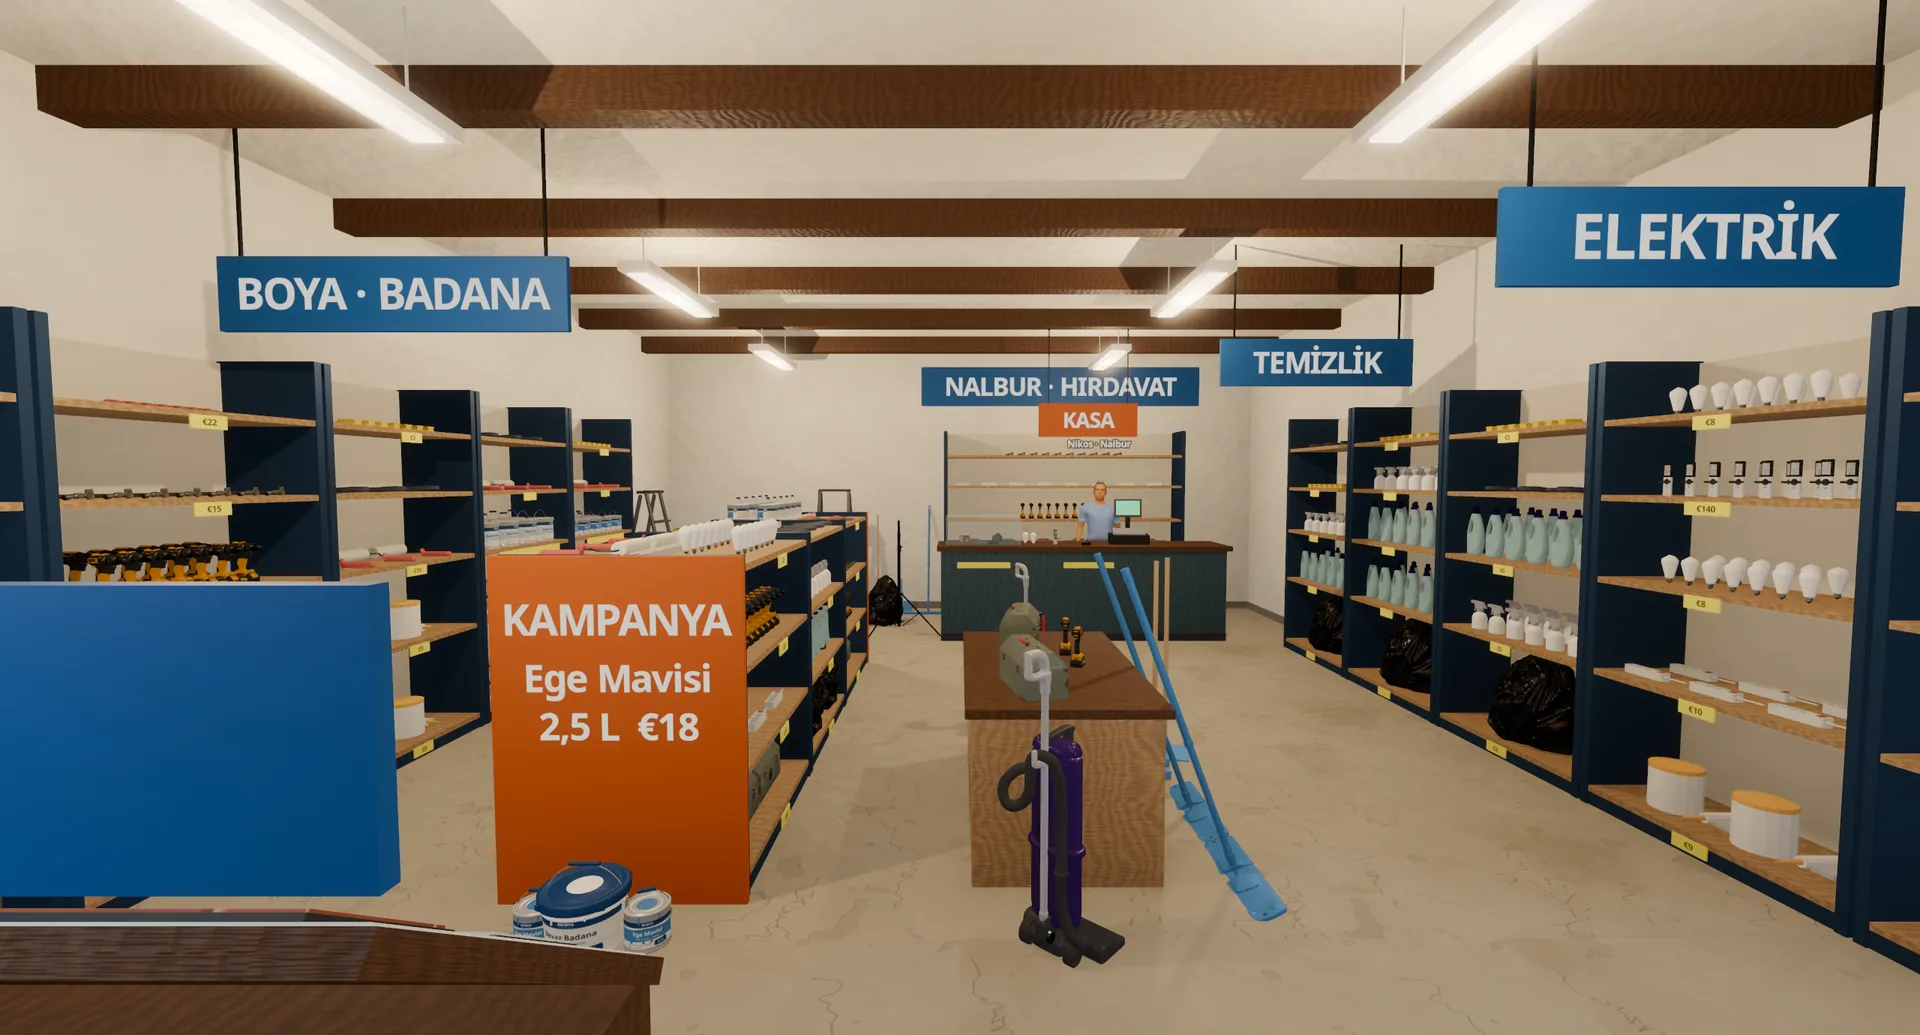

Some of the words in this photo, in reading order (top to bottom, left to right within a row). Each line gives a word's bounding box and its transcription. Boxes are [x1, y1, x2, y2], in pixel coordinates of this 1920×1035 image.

[1574, 199, 1840, 261] ELEKTRİK
[237, 277, 348, 311] BOYA
[379, 277, 552, 311] BADANA
[1253, 344, 1384, 375] TEMİZLİK
[945, 376, 1043, 397] NALBUR
[1060, 376, 1178, 397] HIRDAVAT
[202, 418, 218, 427] €22
[1063, 411, 1116, 429] KASA
[1705, 418, 1716, 427] €8
[207, 505, 222, 513] €15
[1696, 504, 1716, 514] €140
[1696, 599, 1706, 609] €8
[503, 603, 733, 637] KAMPANYA
[525, 664, 588, 702] Ege
[599, 662, 711, 693] Mavisi
[1688, 705, 1703, 716] €10
[539, 712, 591, 746] 2,5
[601, 713, 620, 742] L
[637, 712, 699, 742] €18
[1684, 841, 1694, 851] €9
[564, 930, 597, 941] Badana
